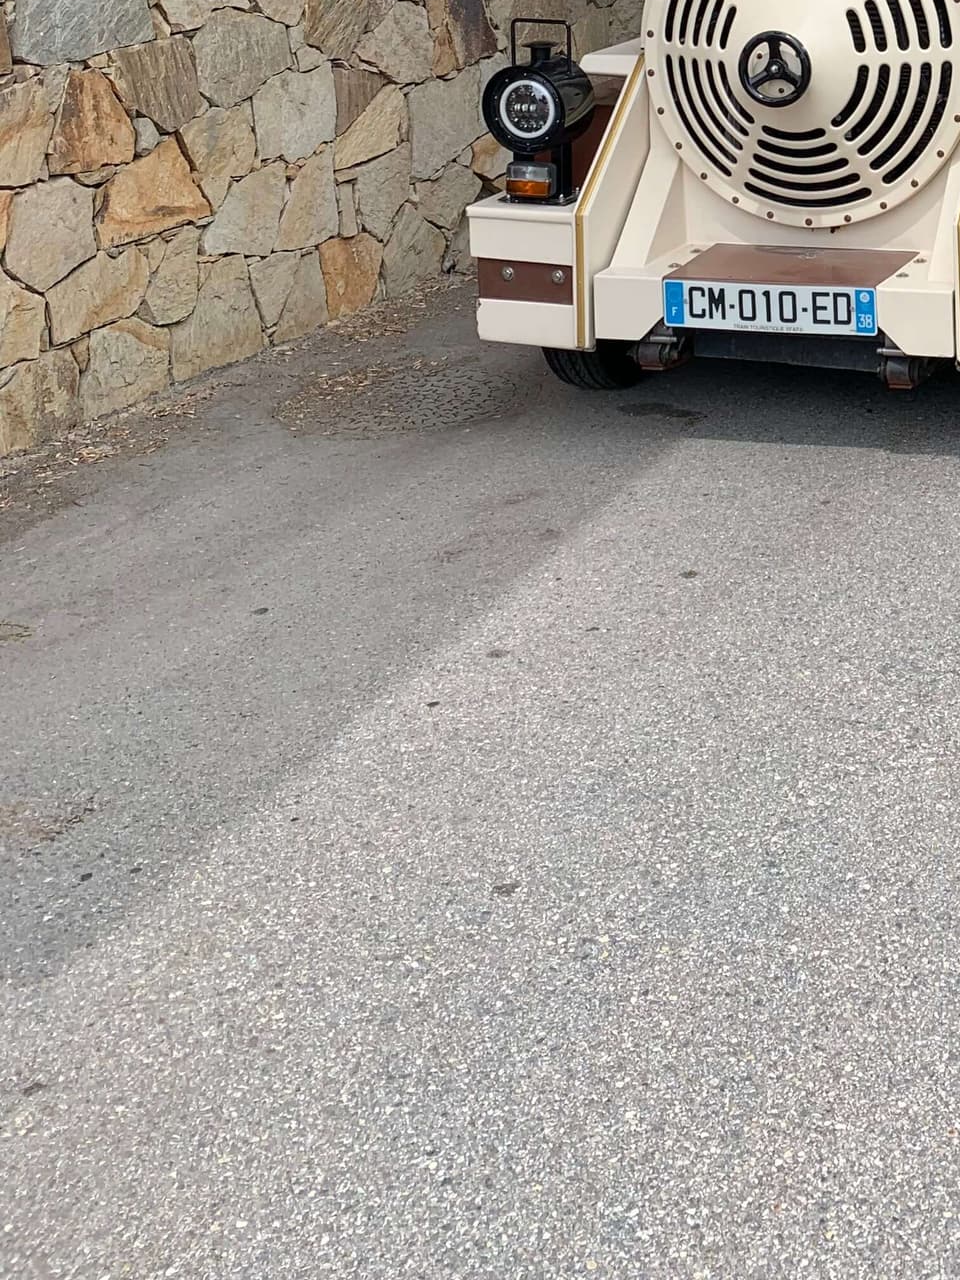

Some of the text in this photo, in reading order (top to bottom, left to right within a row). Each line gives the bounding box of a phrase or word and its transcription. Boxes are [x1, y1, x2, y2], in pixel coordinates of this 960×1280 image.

[671, 306, 679, 317] F
[688, 286, 852, 326] CM-010-ED
[857, 313, 874, 329] 38
